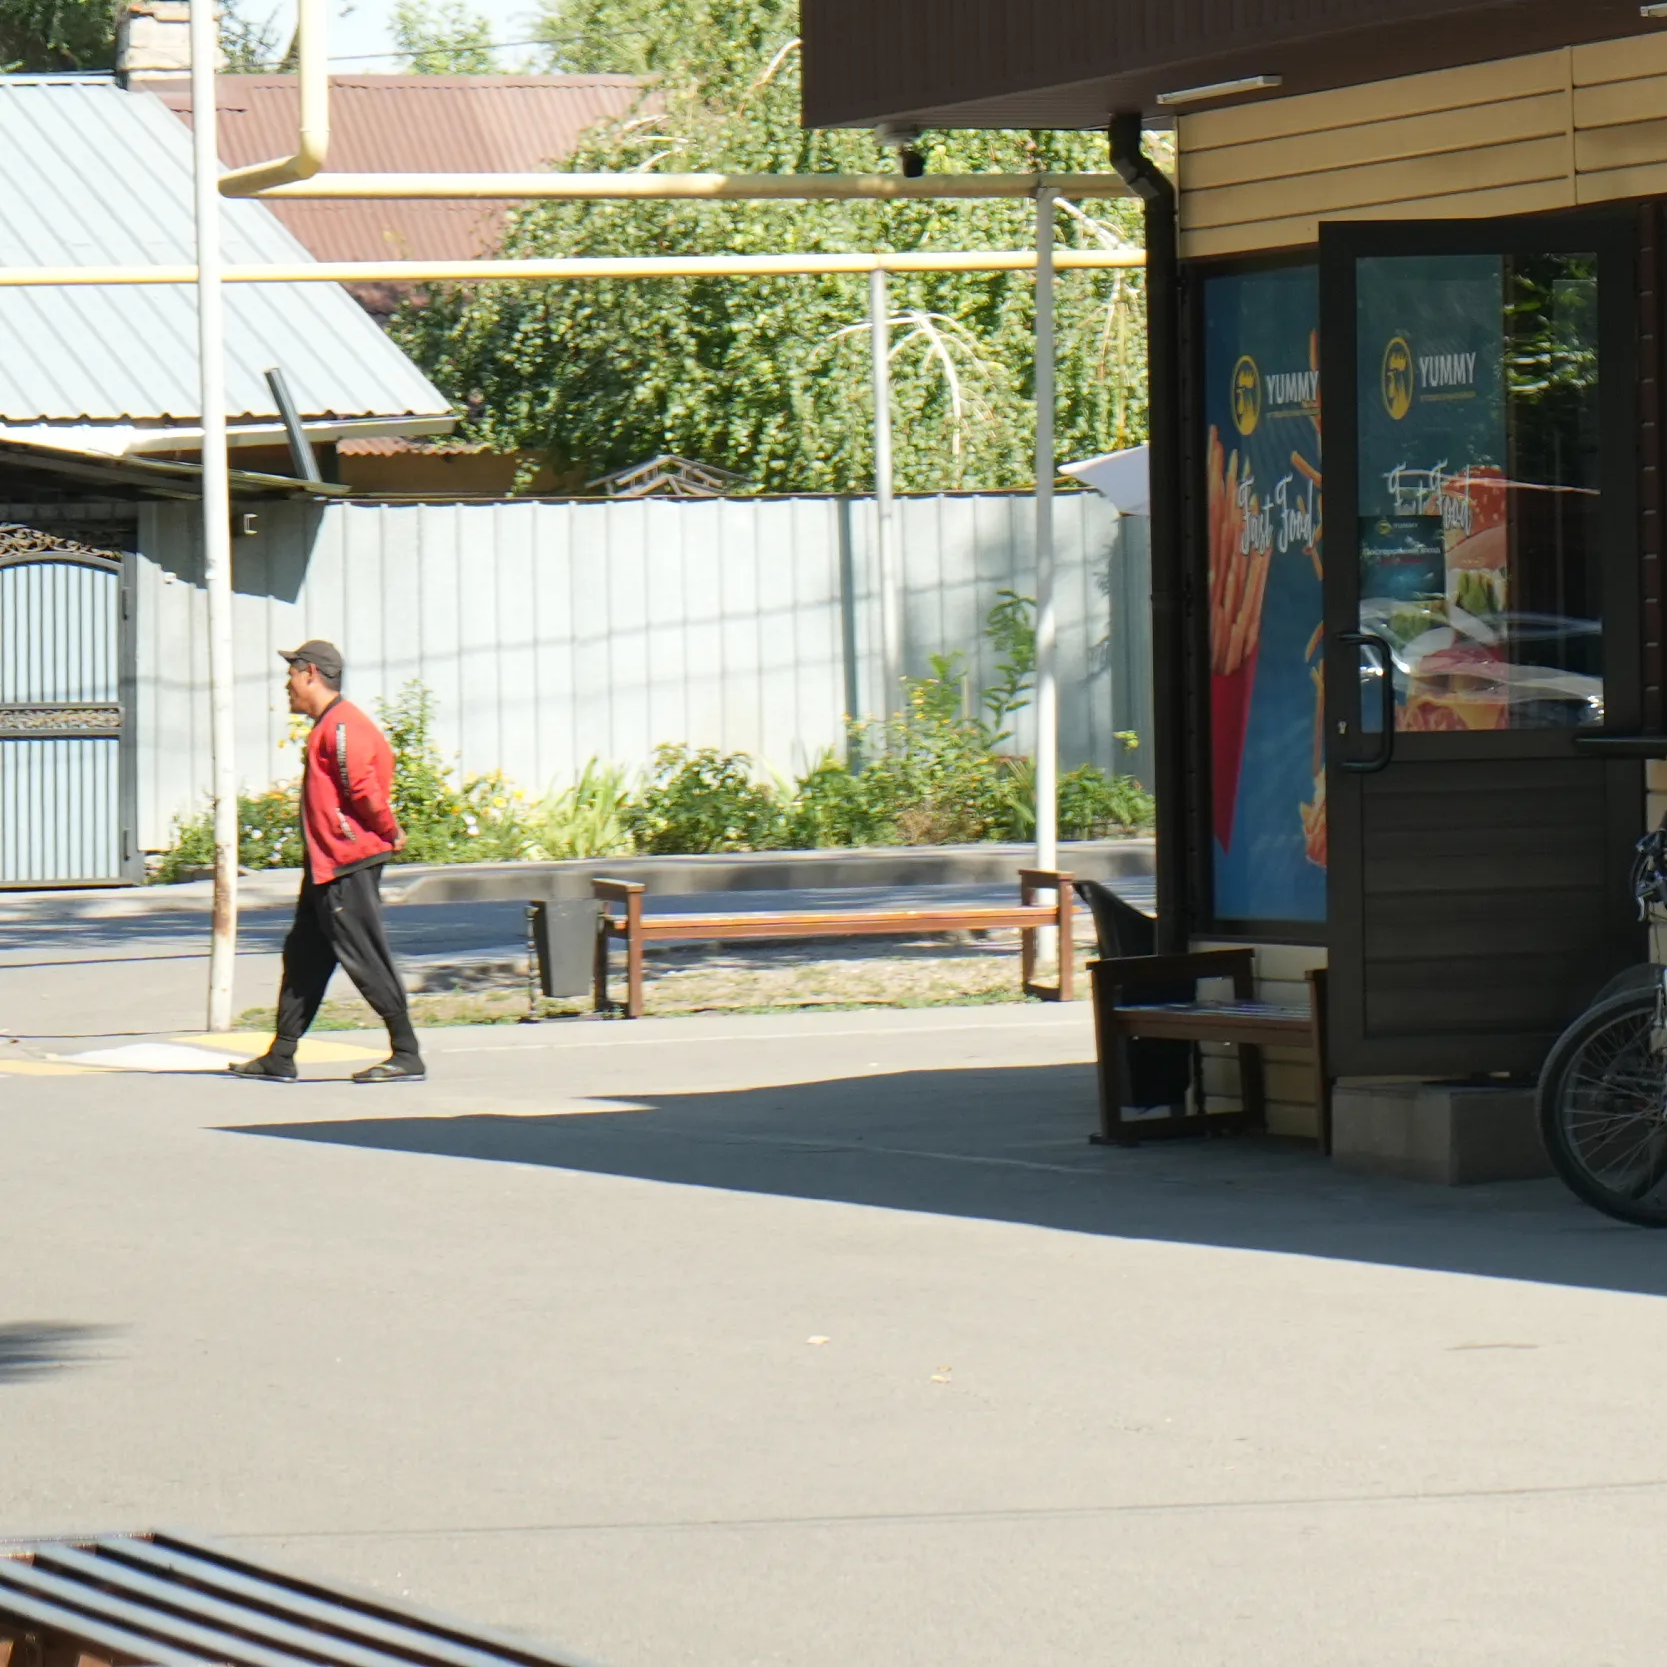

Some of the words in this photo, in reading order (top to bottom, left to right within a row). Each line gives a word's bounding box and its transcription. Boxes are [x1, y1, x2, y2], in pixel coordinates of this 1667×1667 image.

[1265, 370, 1320, 405] YUMMY
[1419, 351, 1477, 388] YUMMY
[1238, 476, 1275, 556] Fast
[1275, 472, 1317, 554] Food
